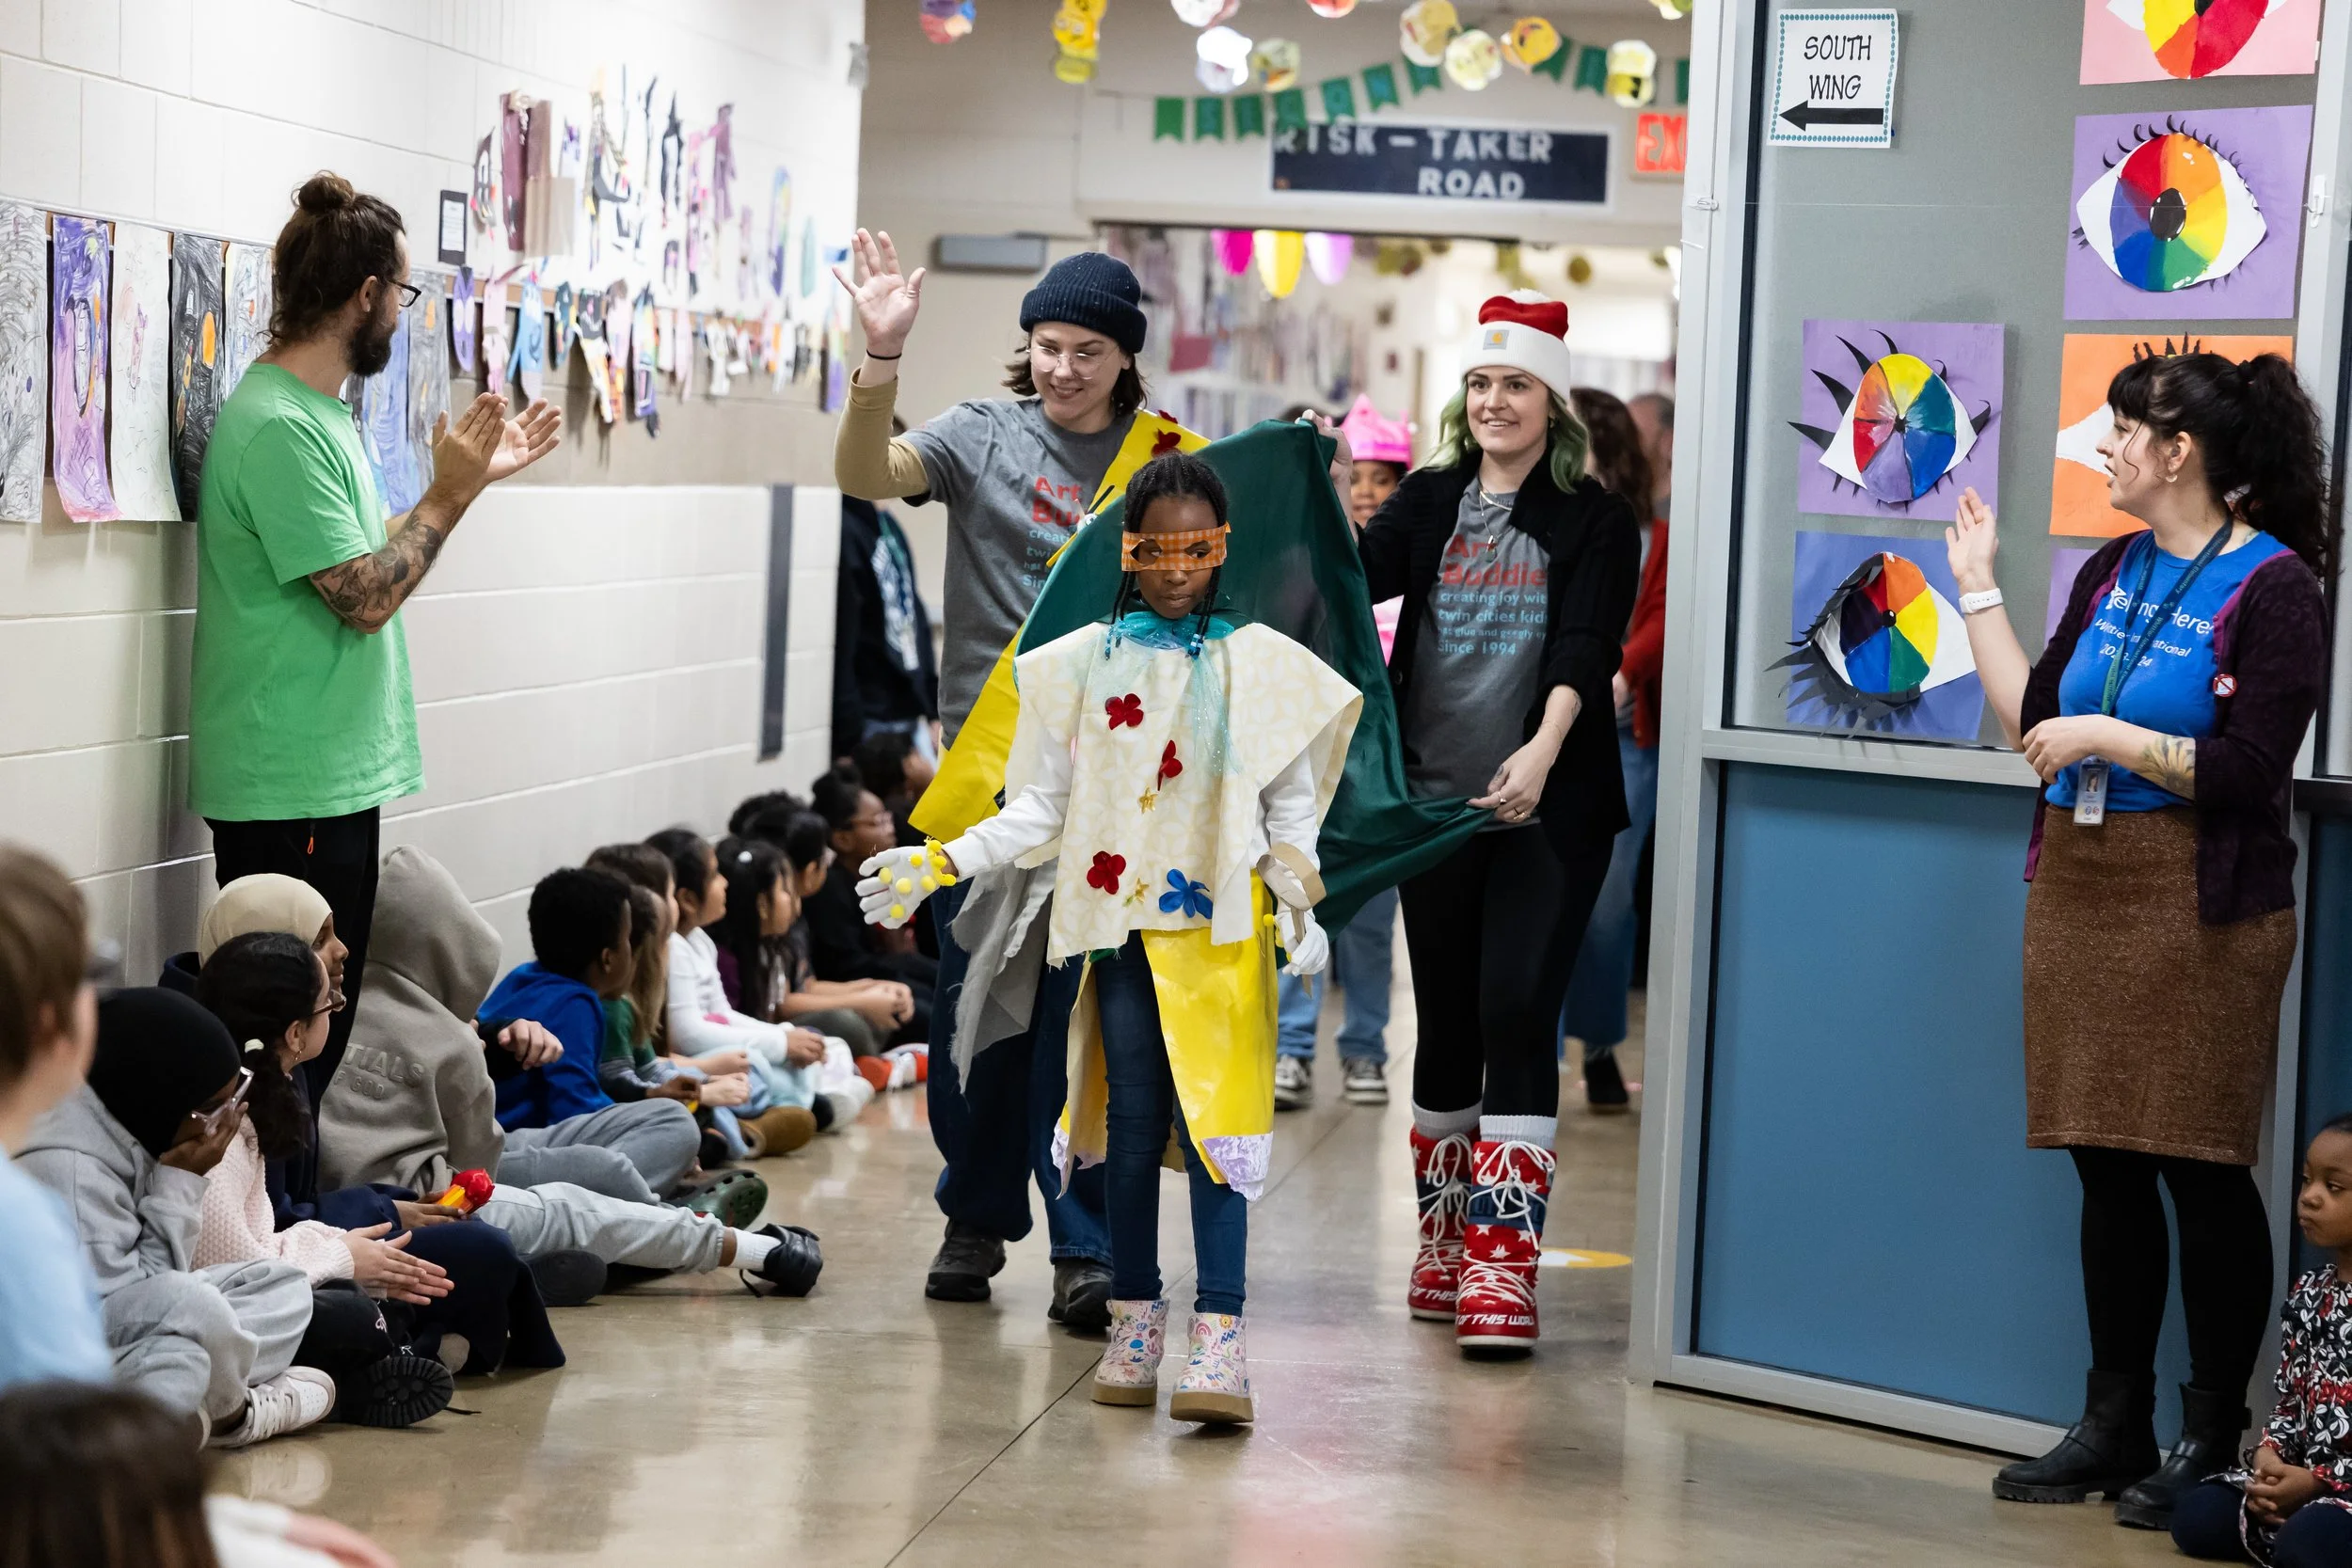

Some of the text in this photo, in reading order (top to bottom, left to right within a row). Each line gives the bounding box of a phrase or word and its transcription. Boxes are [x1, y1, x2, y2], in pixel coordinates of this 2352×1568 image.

[1804, 34, 1872, 61] SOUTH
[1809, 73, 1862, 101] WING
[1635, 113, 1687, 173] EX
[1417, 166, 1526, 200] ROAD
[1034, 476, 1082, 500] Art
[1032, 499, 1080, 527] Bu
[1440, 591, 1497, 608] creating
[1438, 609, 1547, 624] twin cities kid
[1438, 640, 1517, 656] Since 1994
[1470, 1313, 1508, 1325] THIS
